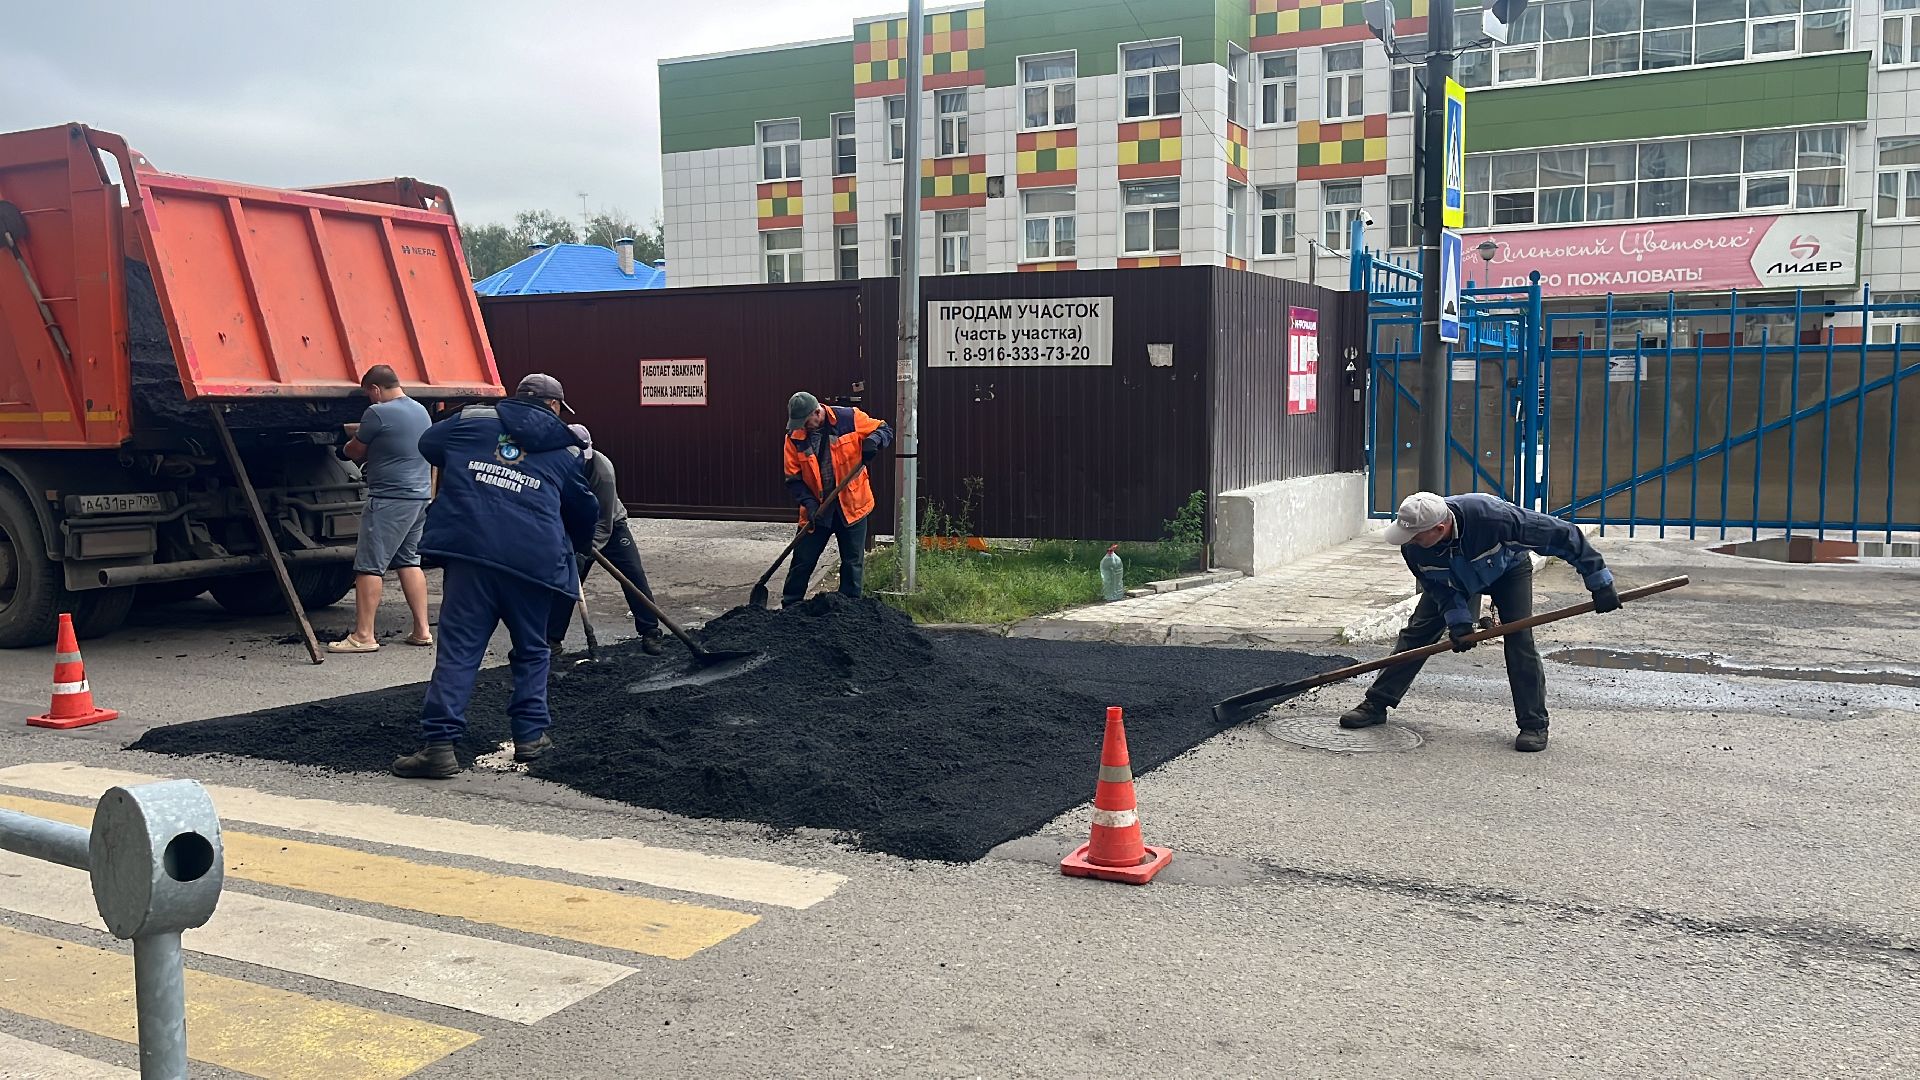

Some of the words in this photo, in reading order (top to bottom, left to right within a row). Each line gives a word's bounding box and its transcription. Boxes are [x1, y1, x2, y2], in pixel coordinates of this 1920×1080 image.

[411, 246, 437, 257] NEFAZ
[1766, 261, 1843, 274] ЛИДЕР
[1567, 267, 1703, 287] ПОЖАЛОВАТЬ!
[940, 304, 1012, 323] ПРОДАМ
[1017, 302, 1100, 320] УЧАСТОК
[954, 326, 1007, 345] (часть
[1011, 324, 1083, 344] участка)
[947, 350, 958, 362] т.
[963, 345, 1090, 362] 8-916-333-73-20
[642, 365, 671, 377] РАБОТАЕТ
[671, 364, 704, 377] ЭВАКУАТОР
[642, 386, 669, 398] СТОЯНКА
[669, 385, 704, 399] ЗАПРЕЩЕНА
[468, 460, 541, 490] БЛАГОУСТРОЙСТВО
[475, 472, 522, 493] БАЛАШИХА
